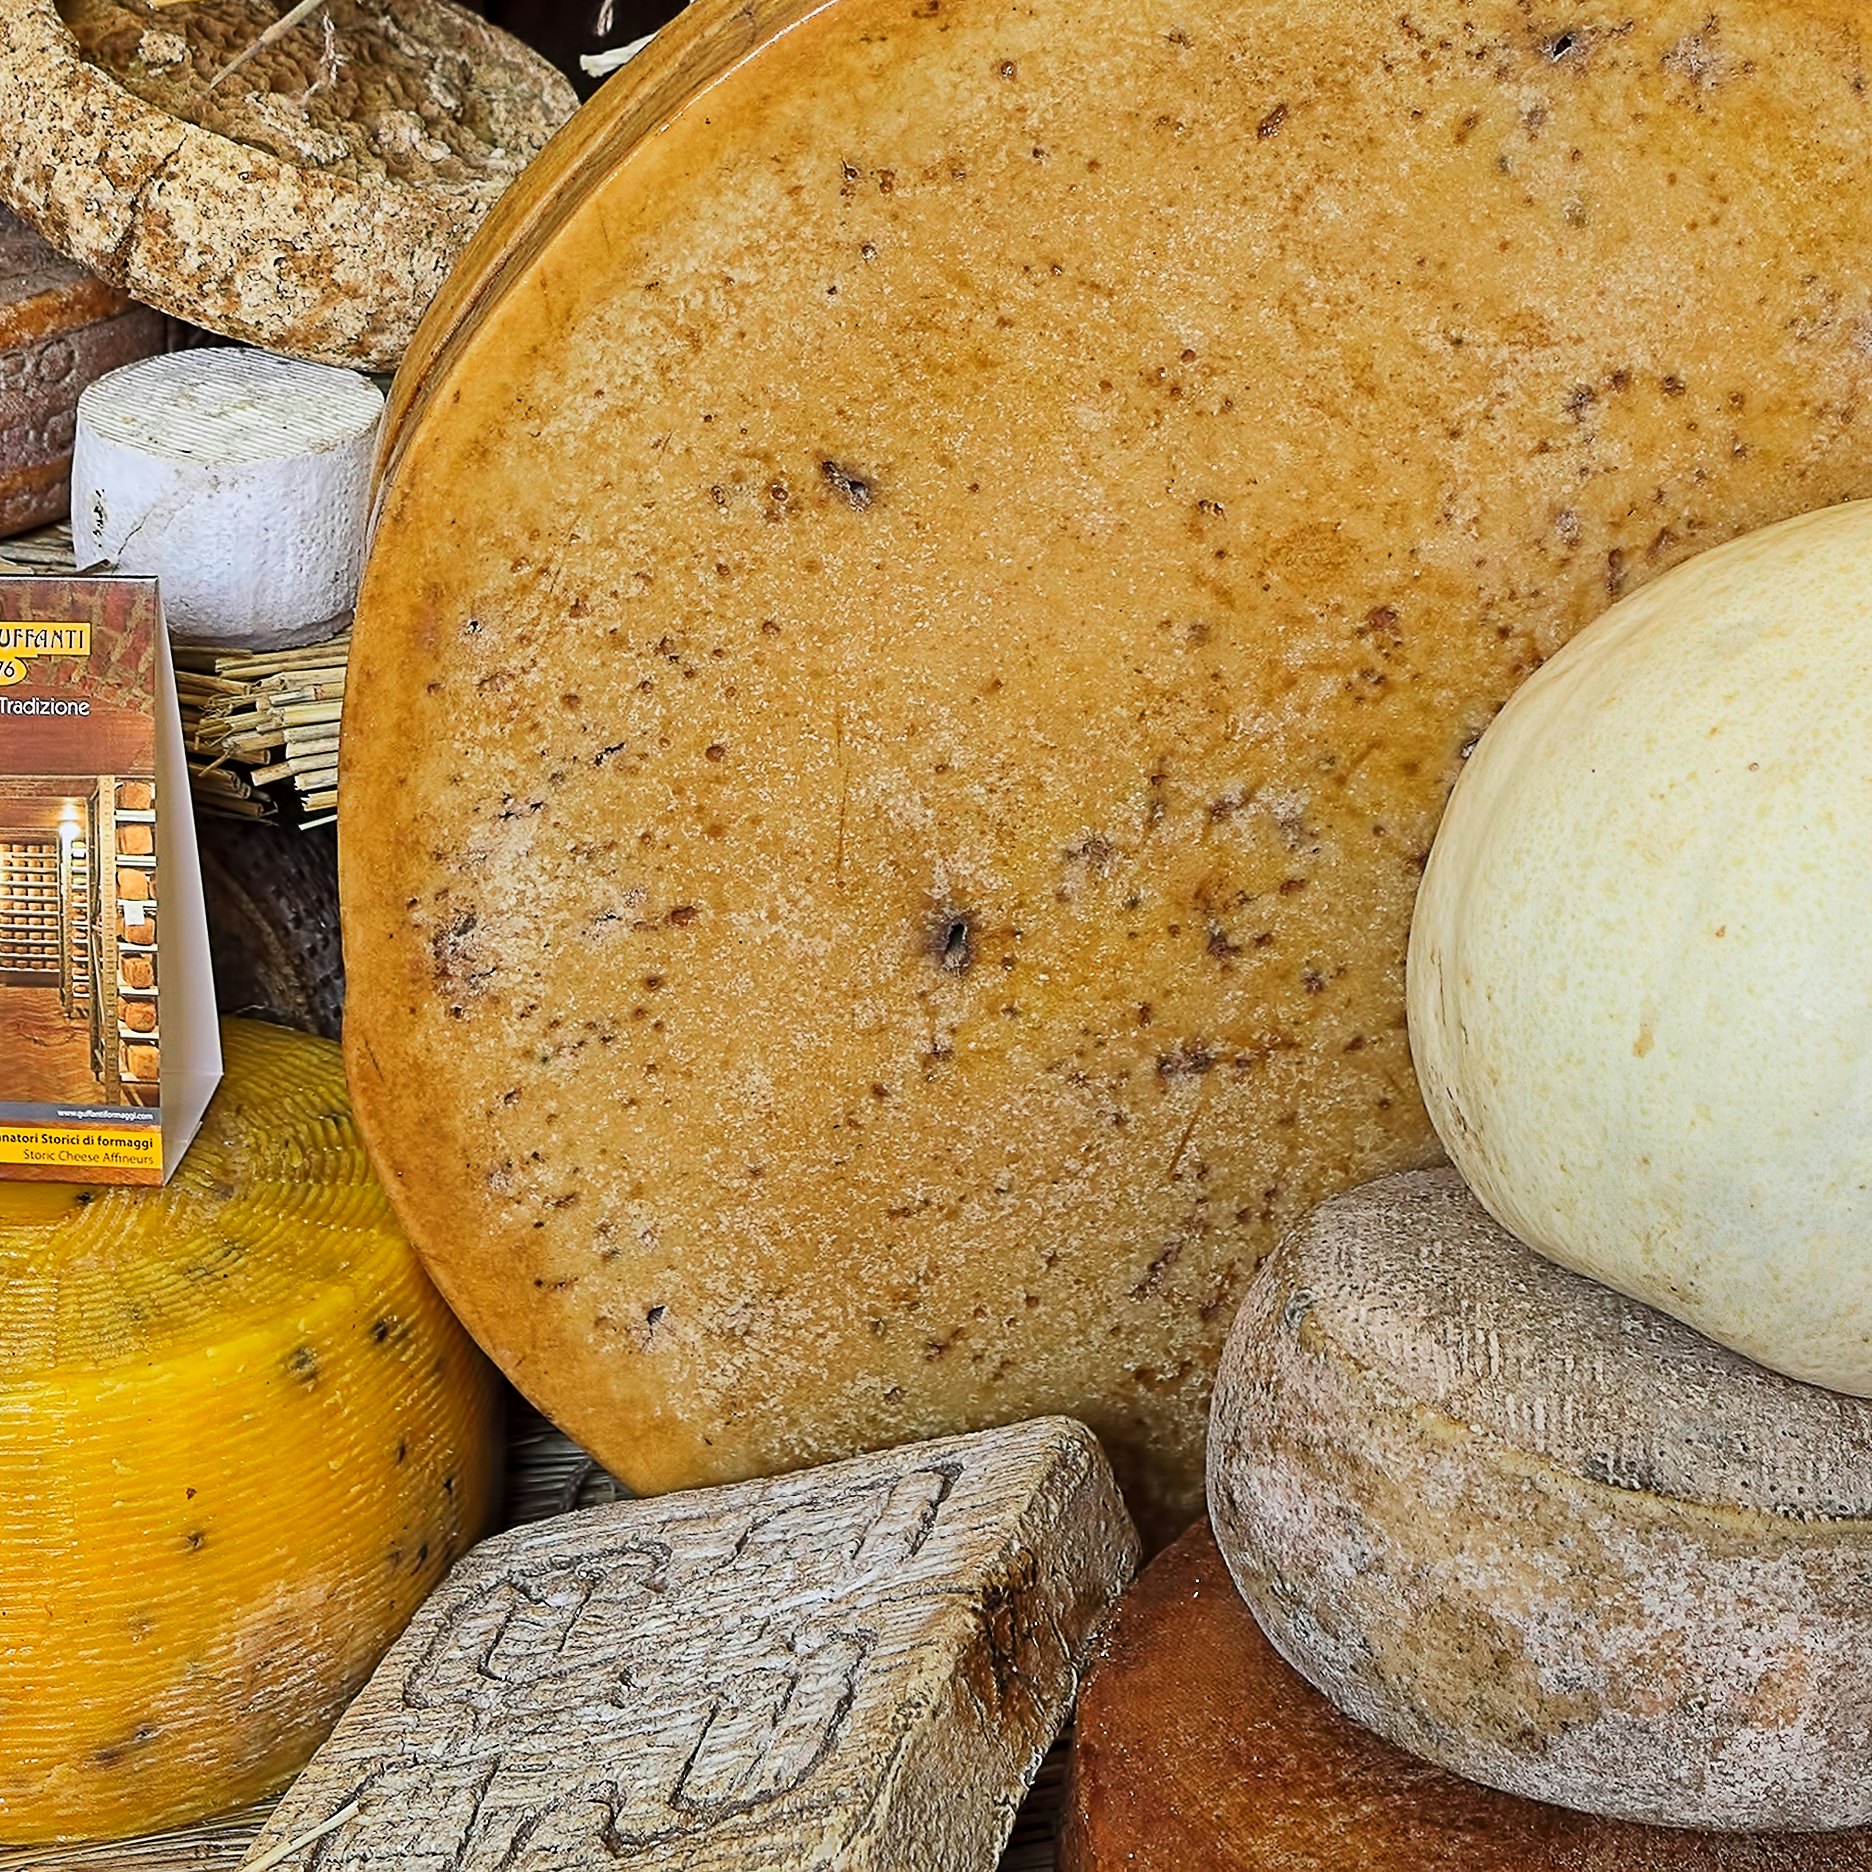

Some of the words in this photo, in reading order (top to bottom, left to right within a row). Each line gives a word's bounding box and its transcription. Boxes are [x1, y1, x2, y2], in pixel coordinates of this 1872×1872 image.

[41, 1133, 80, 1146] Storici
[82, 1134, 95, 1146] di
[97, 1136, 154, 1151] formaggi
[23, 1148, 55, 1161] Storic
[58, 1150, 99, 1163] Cheese
[102, 1152, 154, 1165] Affineurs
